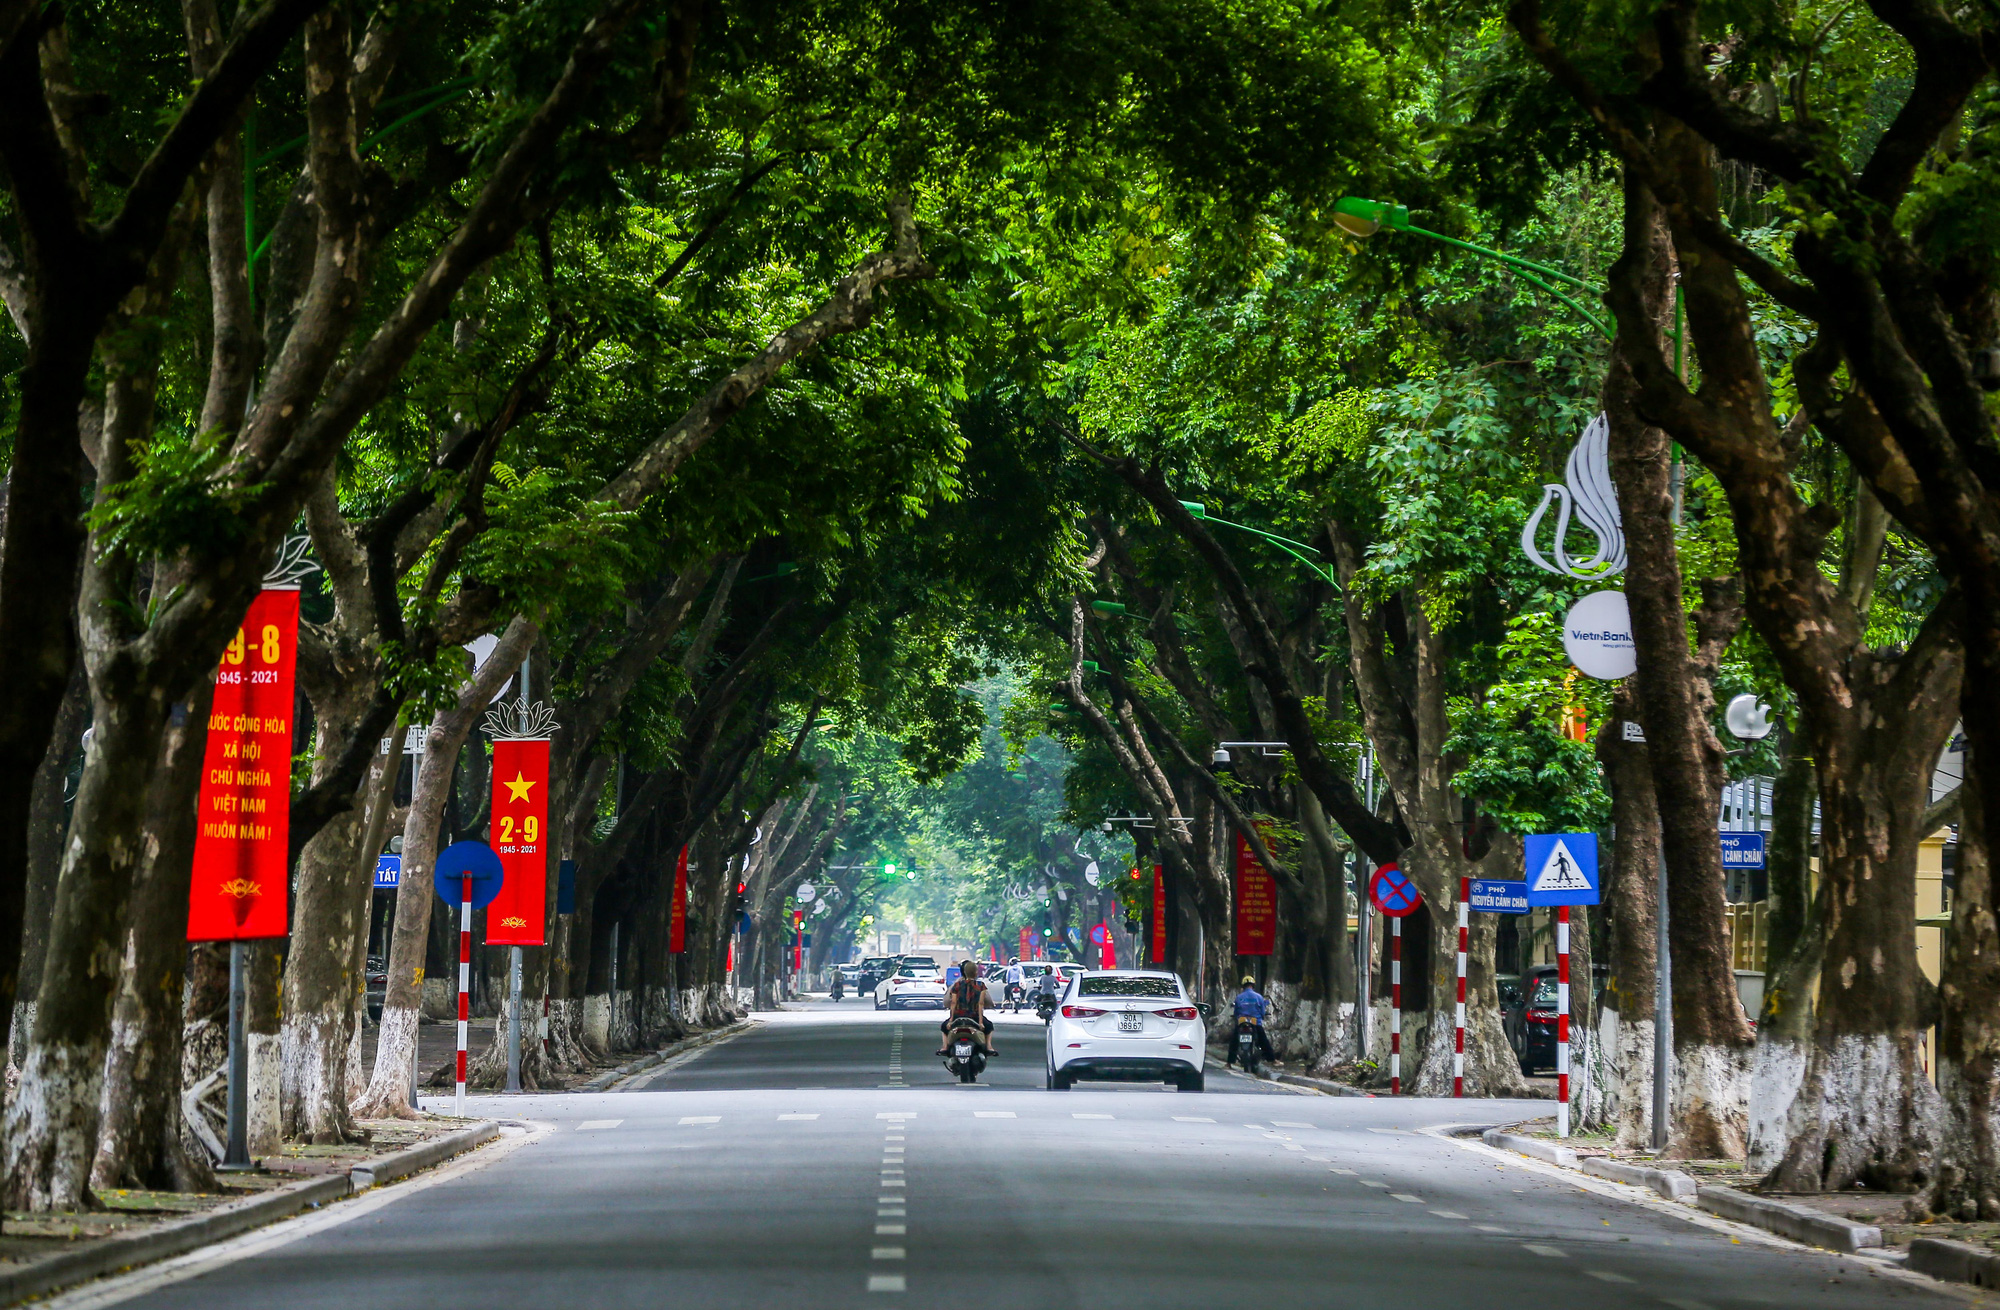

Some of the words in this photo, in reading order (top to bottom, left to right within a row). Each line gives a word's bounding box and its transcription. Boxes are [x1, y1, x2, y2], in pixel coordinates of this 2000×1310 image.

[1571, 630, 1632, 641] VietinBank
[251, 670, 278, 683] 2021
[207, 711, 230, 731] ƯỚC
[234, 713, 260, 735] CỘNG
[264, 715, 285, 734] HÒA
[223, 740, 238, 758] XÃ
[242, 740, 261, 762] HỘI
[210, 764, 233, 785] CHỦ
[236, 769, 271, 787] NGHĨA
[213, 793, 237, 814] VIỆT
[241, 798, 266, 813] NAM
[204, 820, 236, 839] MUÔN
[500, 815, 538, 843] 2-9
[499, 845, 516, 854] 1945
[520, 845, 536, 854] 2021
[1720, 837, 1740, 847] PHỐ
[1725, 846, 1743, 863] CẢNH
[1743, 848, 1762, 863] CHÂN
[378, 866, 397, 882] TẤT
[1488, 885, 1506, 893] PHỐ
[1472, 892, 1495, 907] NGUYỄN
[1495, 893, 1512, 907] CẢNH
[1512, 896, 1528, 908] CHÂN
[1123, 1014, 1137, 1022] 90A
